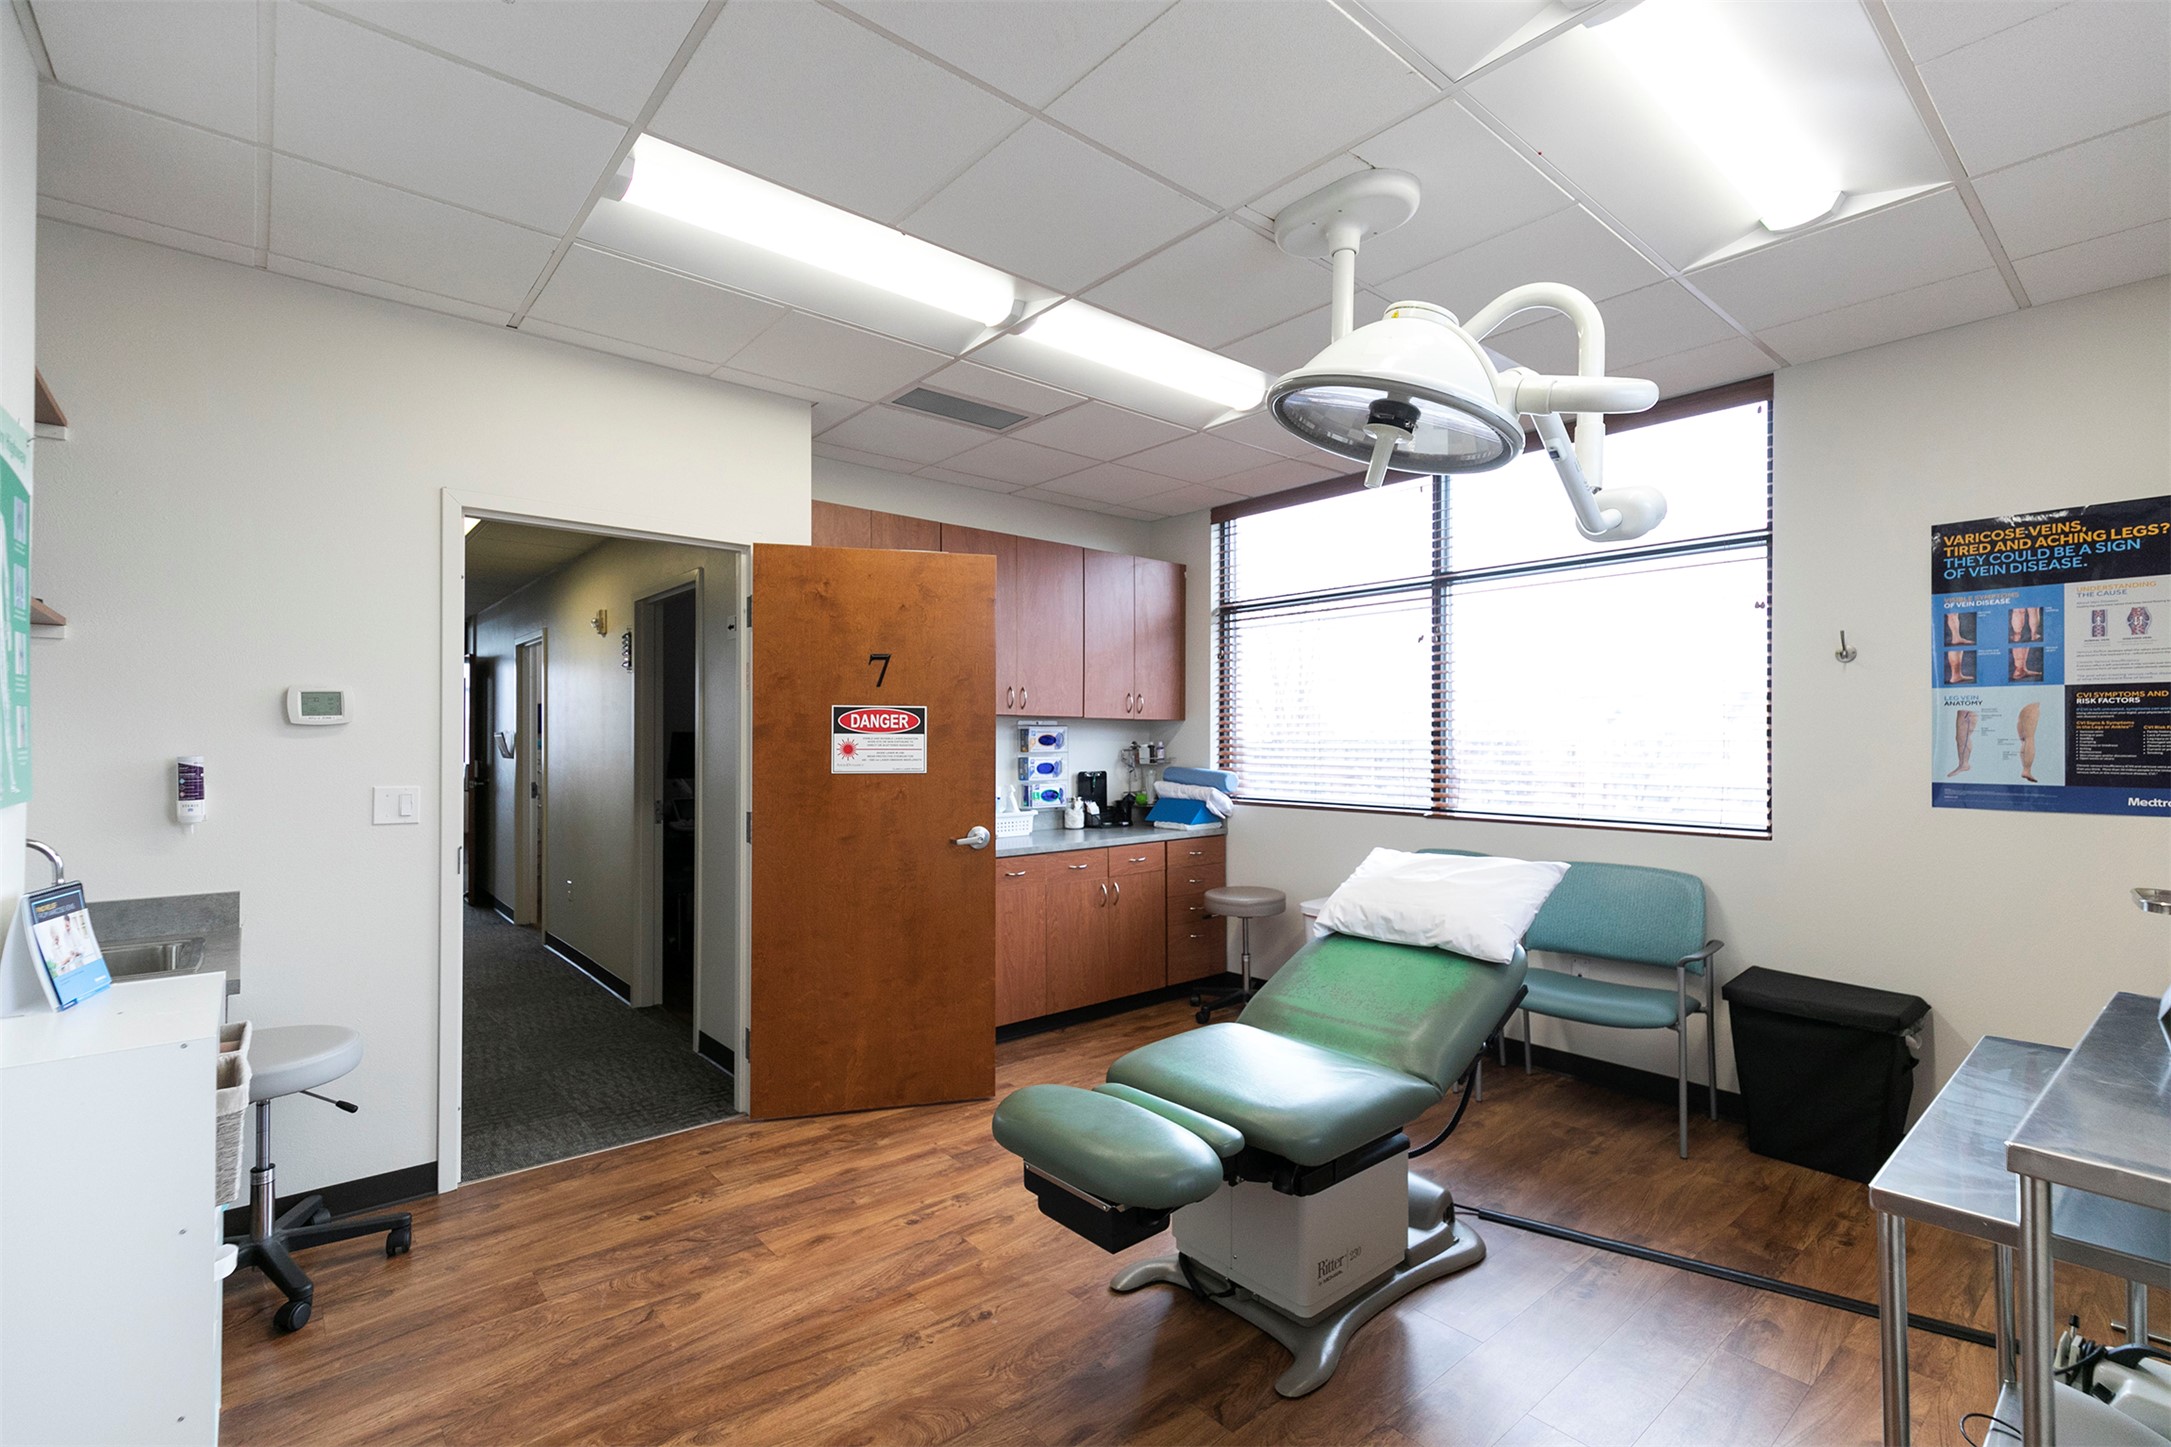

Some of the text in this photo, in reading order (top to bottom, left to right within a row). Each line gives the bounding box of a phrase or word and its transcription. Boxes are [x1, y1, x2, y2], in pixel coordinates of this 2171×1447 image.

[1943, 520, 2087, 546] VARICOSE VEINS,
[1943, 522, 2171, 557] TIRED AND ACHING LEGS?
[1943, 538, 2141, 569] THEY COULD BE A SIGN
[1943, 556, 2088, 580] OF VEIN DISEASE.
[2076, 581, 2157, 593] UNDERSTANDING
[2096, 589, 2128, 597] CAUSE
[1956, 600, 1975, 608] VEIN
[1976, 598, 2011, 606] DISEASE
[868, 653, 892, 688] 7
[850, 713, 909, 729] DANGER
[1317, 1255, 1344, 1279] Ritter
